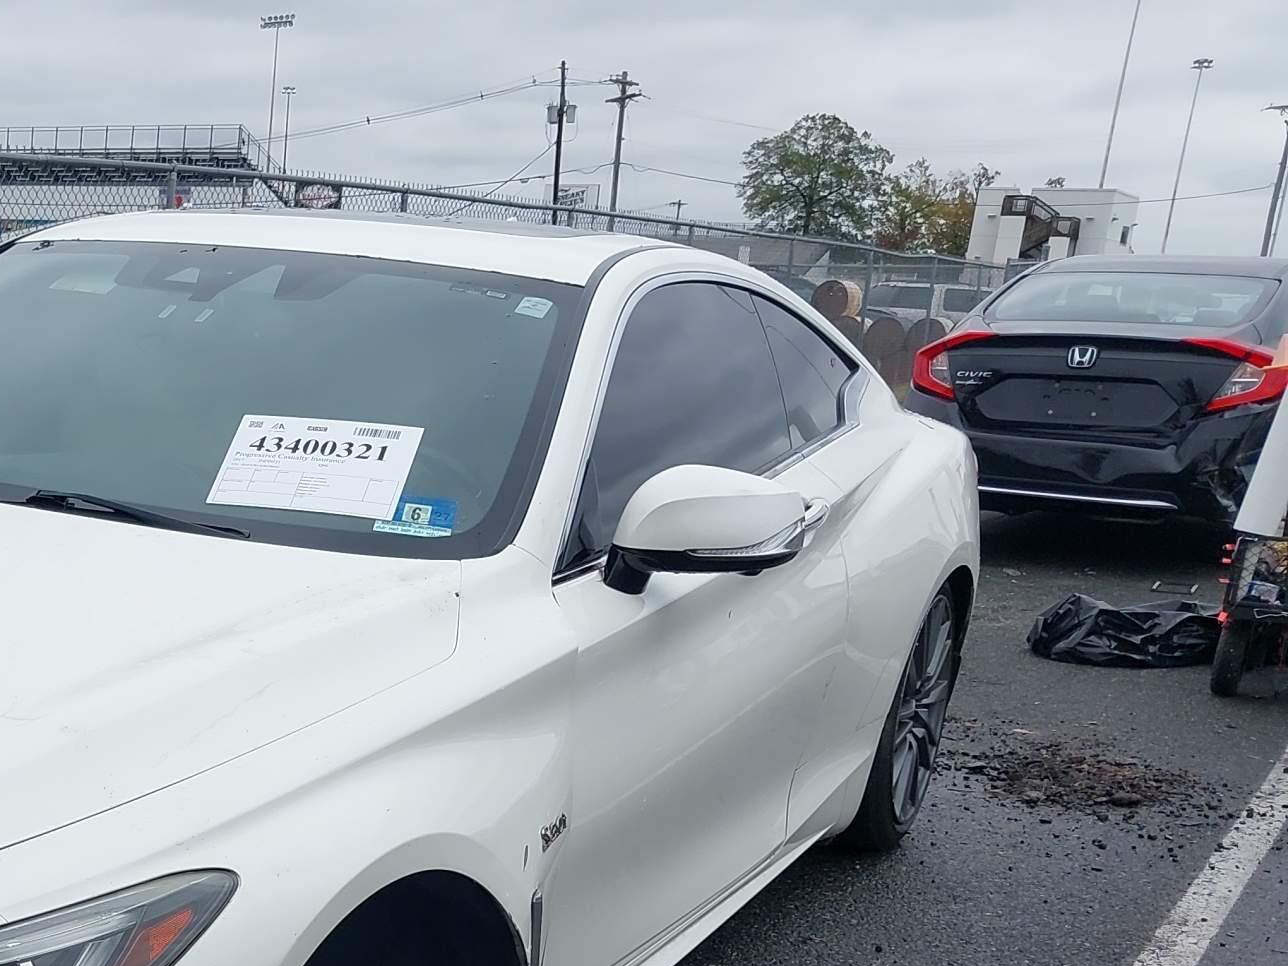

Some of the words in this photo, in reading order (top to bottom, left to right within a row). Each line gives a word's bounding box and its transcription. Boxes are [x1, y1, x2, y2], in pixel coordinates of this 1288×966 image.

[956, 370, 993, 378] CIVIC
[249, 435, 389, 462] 43400321
[411, 507, 422, 521] 6
